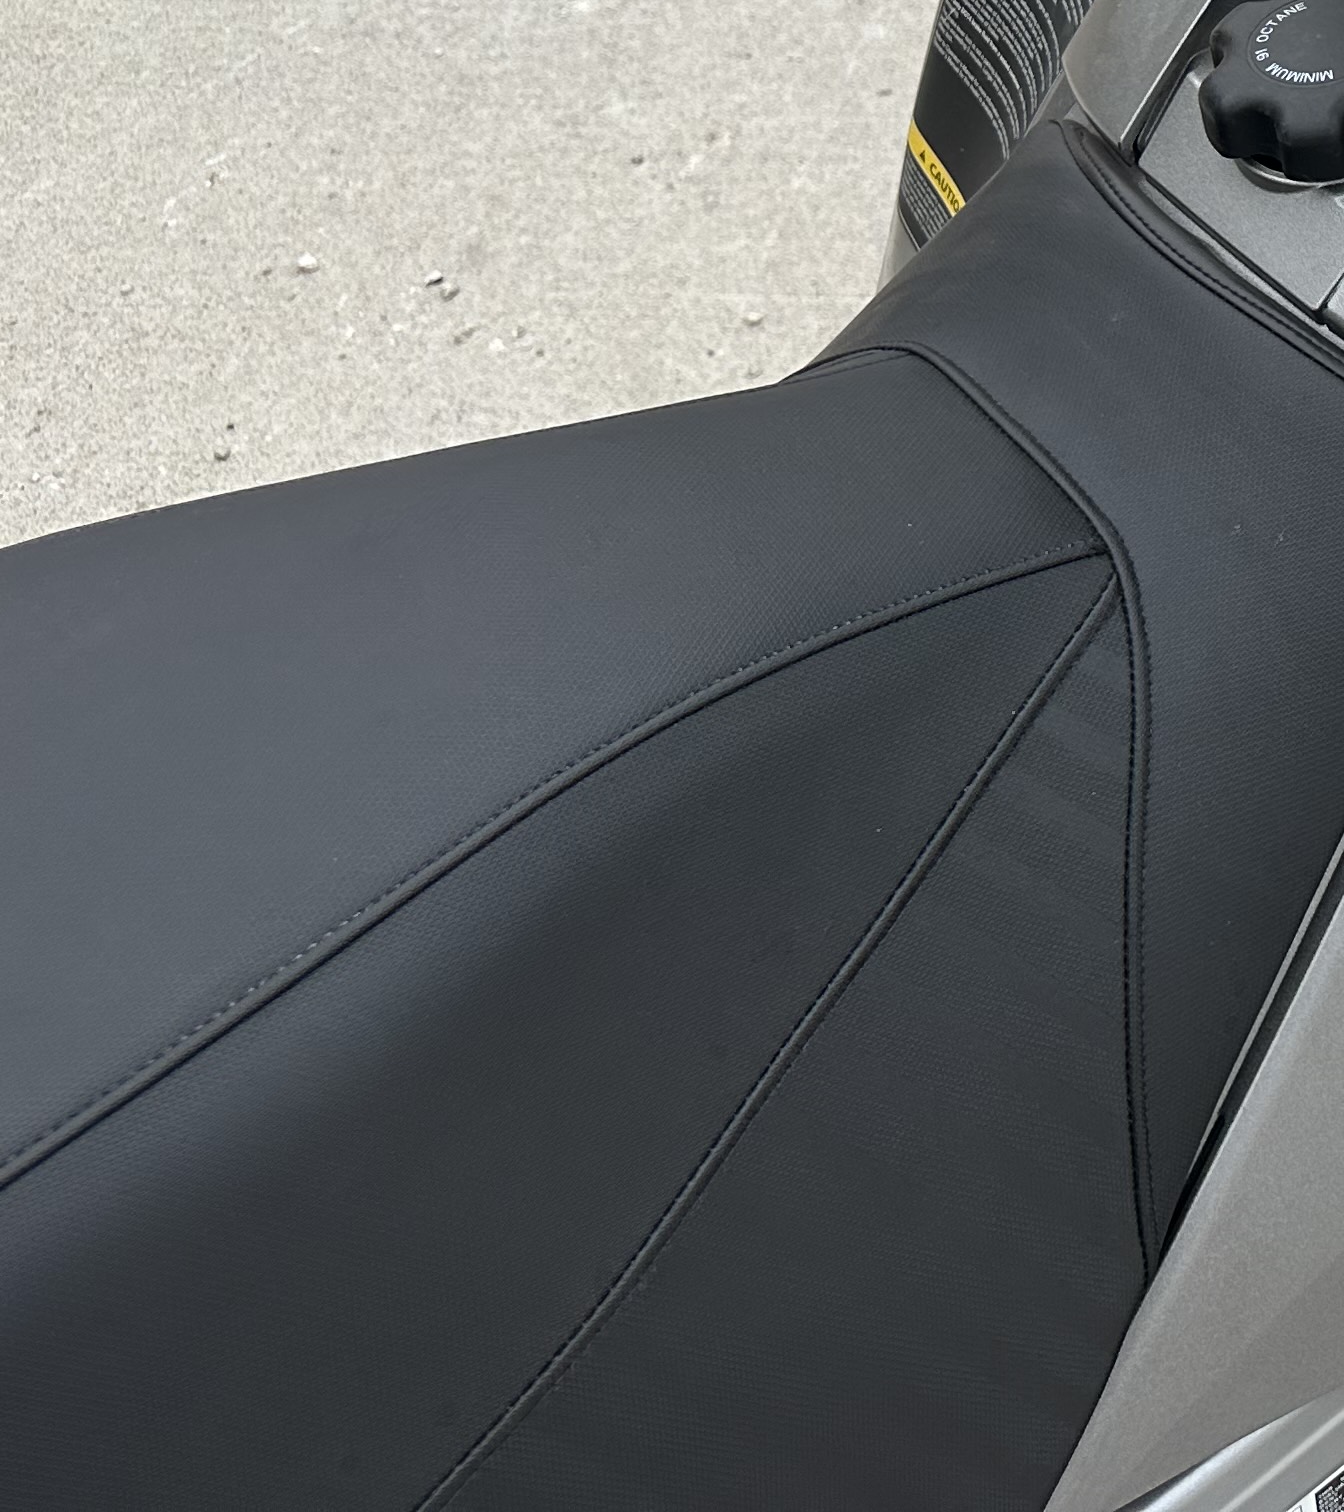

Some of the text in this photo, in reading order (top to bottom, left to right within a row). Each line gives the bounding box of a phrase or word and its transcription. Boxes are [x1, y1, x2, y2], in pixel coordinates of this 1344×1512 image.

[1256, 1, 1308, 43] OCTANE
[1255, 47, 1270, 62] 91
[1265, 62, 1334, 83] MINIMUM
[929, 163, 960, 213] CAUTIO
